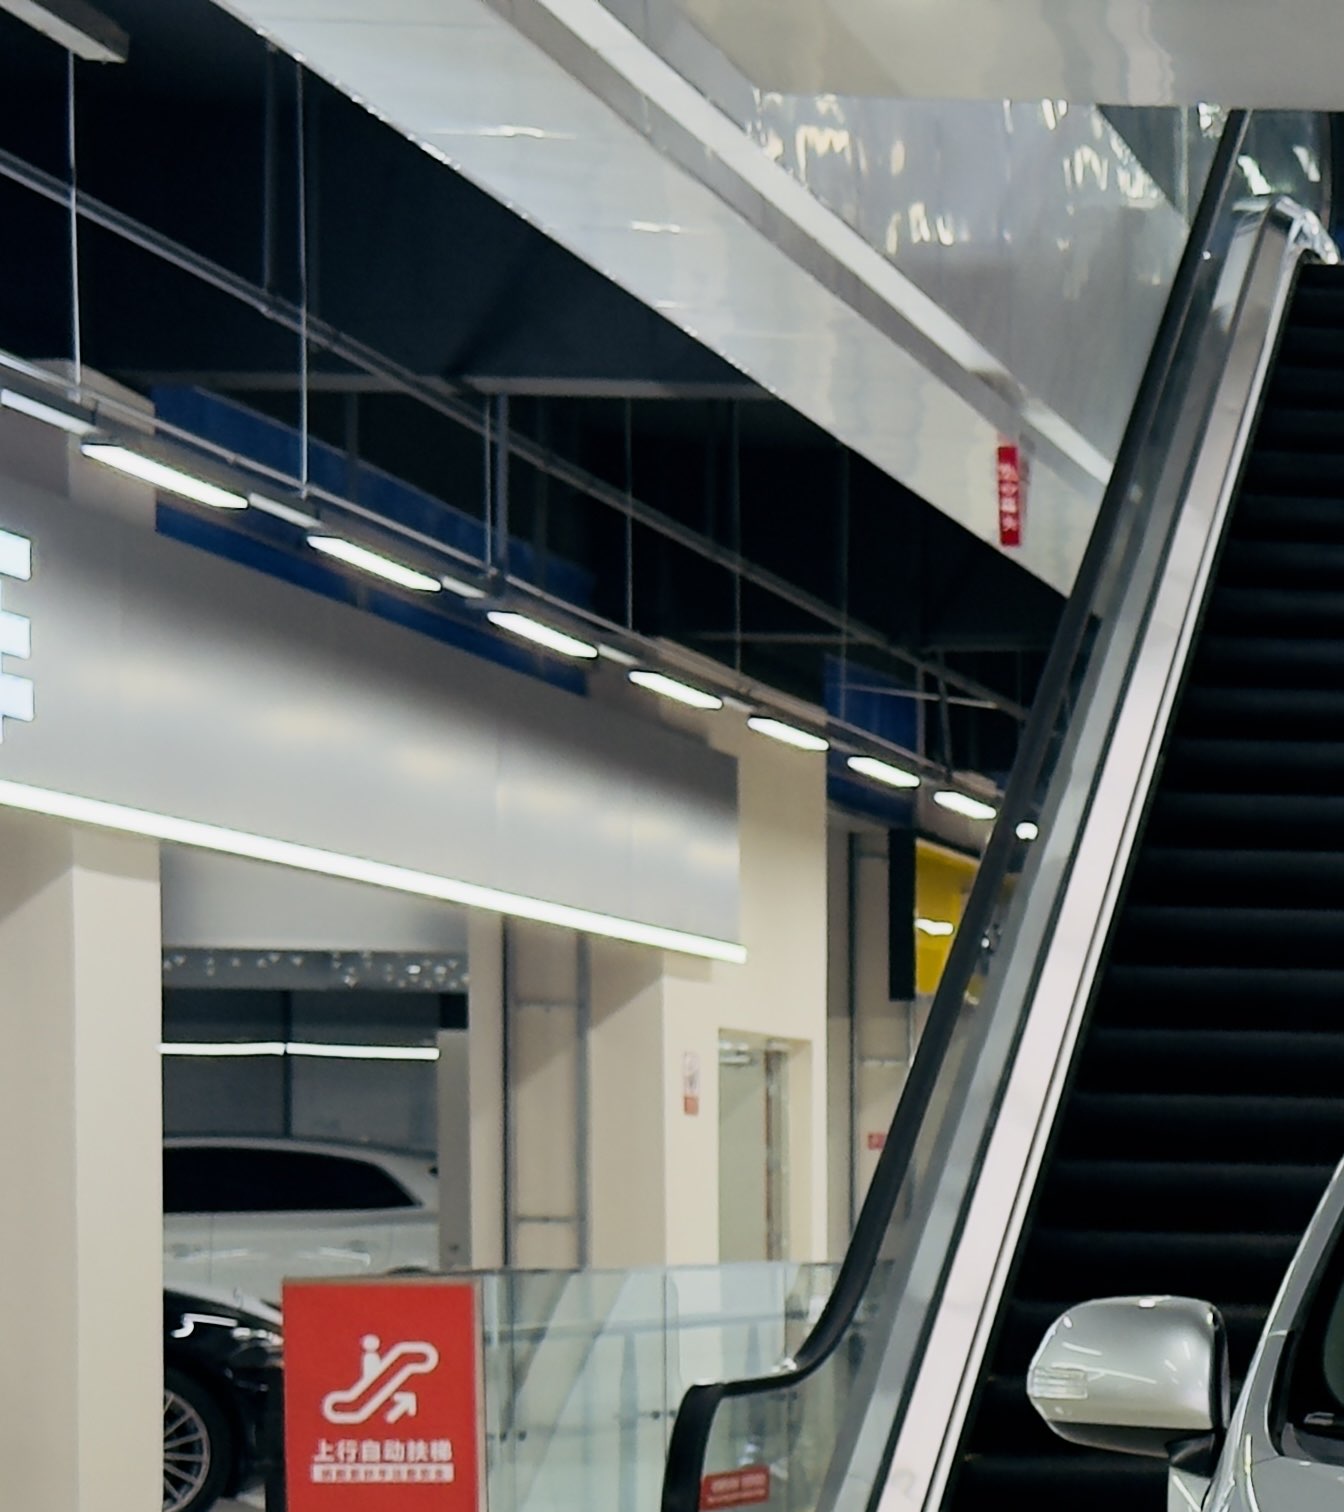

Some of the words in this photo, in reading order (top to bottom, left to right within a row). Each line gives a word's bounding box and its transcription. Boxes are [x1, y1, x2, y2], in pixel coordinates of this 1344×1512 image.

[313, 1438, 453, 1462] 上行自动扶梯
